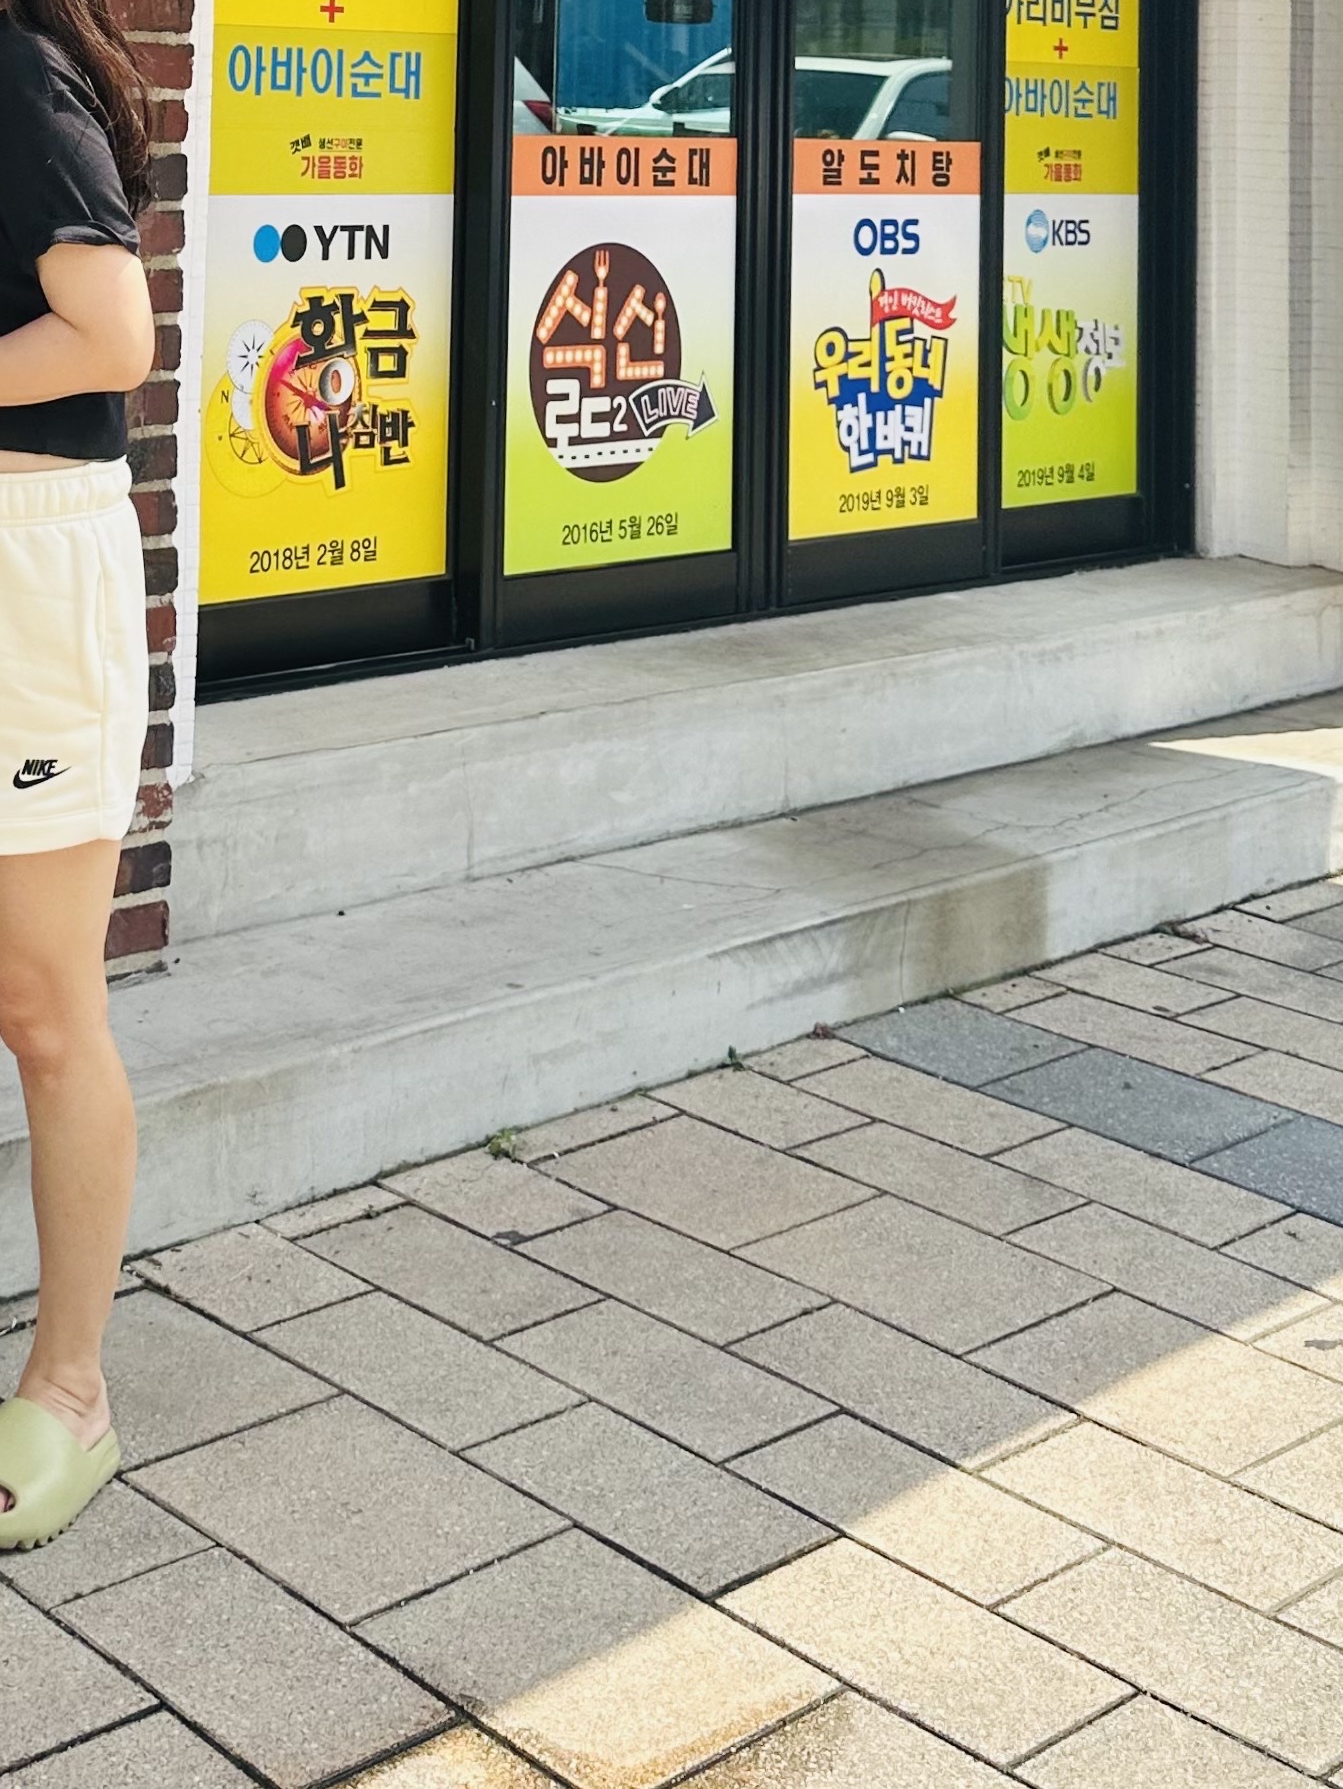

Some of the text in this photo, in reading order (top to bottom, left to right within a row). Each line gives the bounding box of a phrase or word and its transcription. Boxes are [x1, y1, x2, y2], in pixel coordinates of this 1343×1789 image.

[228, 45, 422, 101] 아바이순대
[1005, 76, 1118, 119] 아바이순대
[301, 155, 363, 179] 가을동화
[541, 145, 711, 188] 아바이순대
[313, 224, 390, 261] YTN
[853, 219, 920, 256] OBS
[1051, 219, 1090, 246] KBS
[641, 385, 700, 424] LIVE
[1017, 461, 1095, 487] 2019년 9월 4일
[839, 484, 929, 514] 2019년 9월 3일
[562, 512, 678, 546] 2016년 5월 26일
[249, 536, 378, 574] 2018년 2월 8일
[22, 759, 57, 777] NIKE
